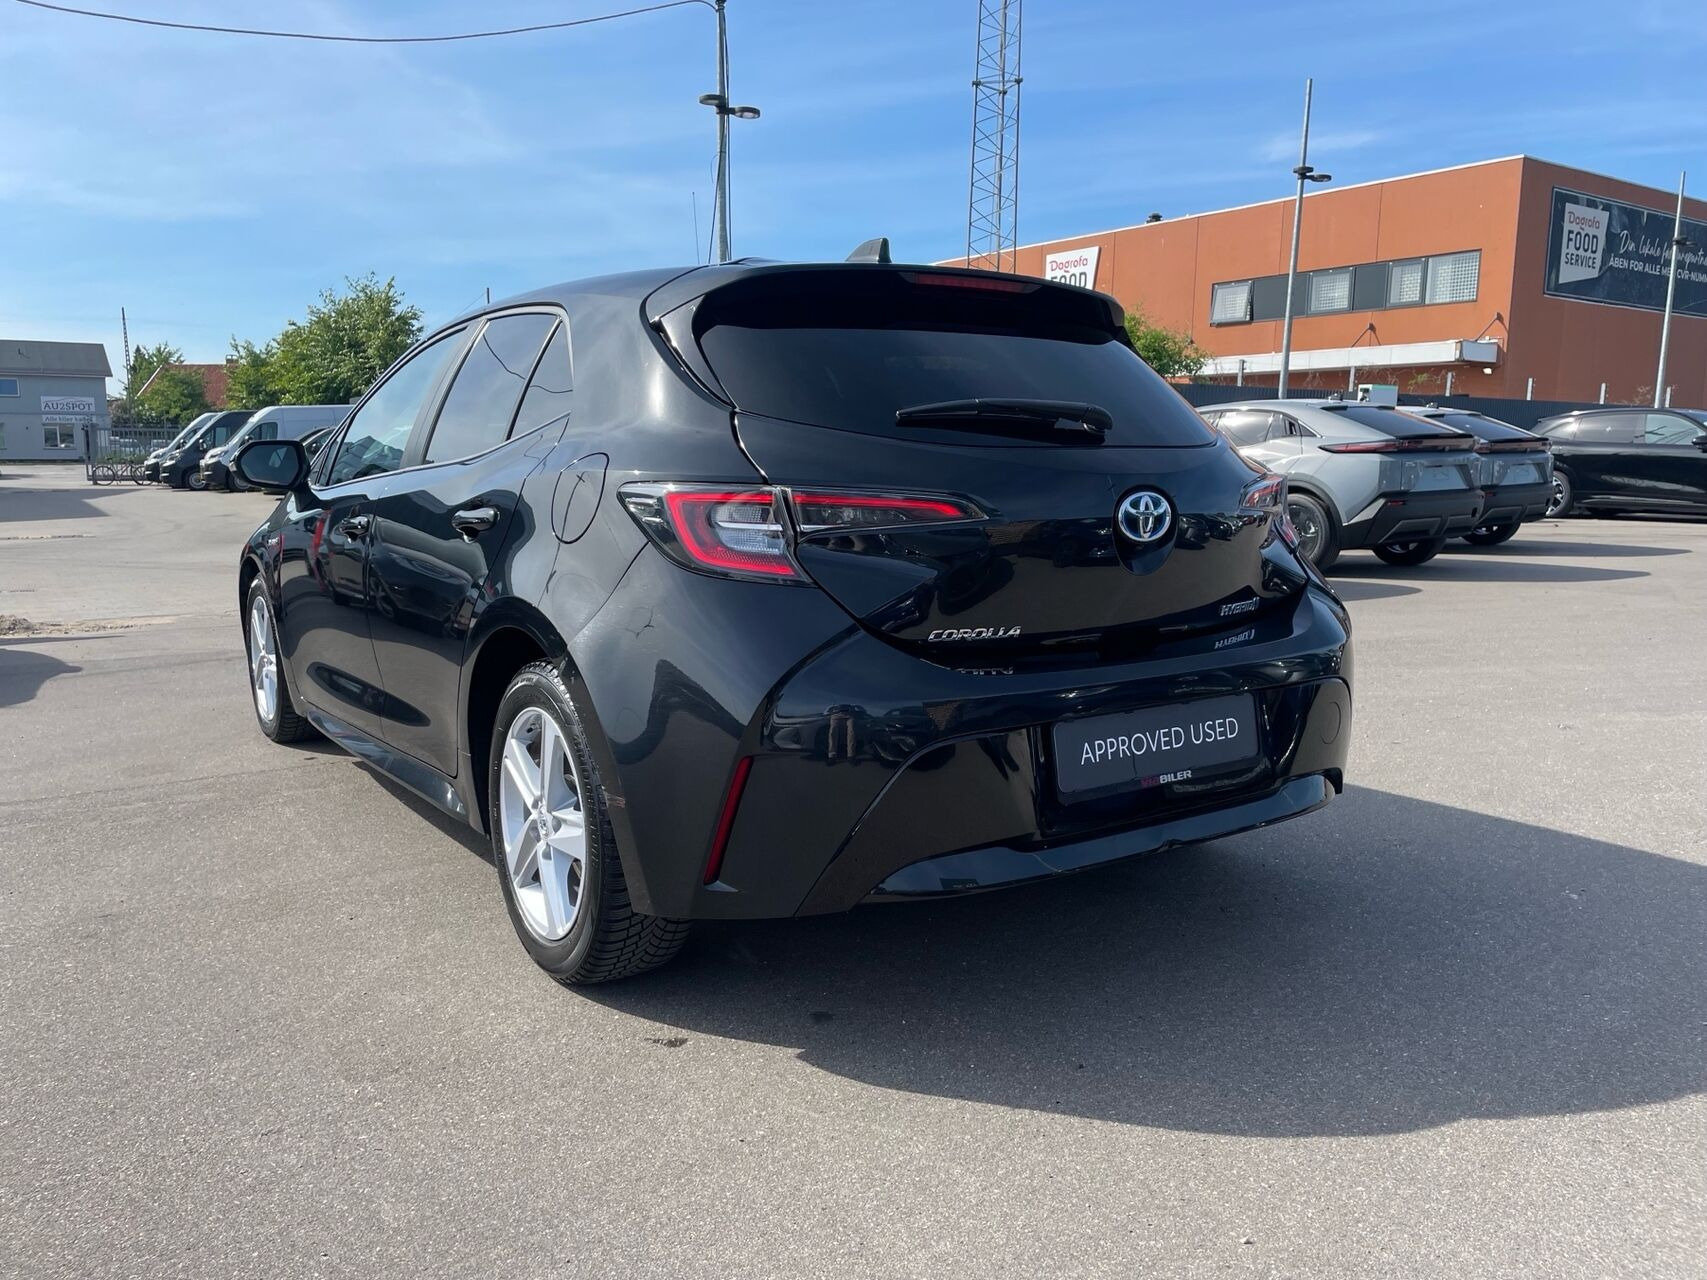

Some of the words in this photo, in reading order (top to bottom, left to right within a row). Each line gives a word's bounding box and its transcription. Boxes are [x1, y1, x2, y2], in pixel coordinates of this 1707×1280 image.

[1567, 211, 1600, 231] Dagrofa
[1566, 229, 1599, 254] FOOD
[1049, 256, 1088, 273] Dagrofa
[1564, 252, 1597, 269] SERVICE
[1609, 253, 1628, 268] ÅBEN
[1629, 261, 1644, 273] FOR
[1644, 264, 1661, 275] ALLE
[43, 401, 93, 411] AU2SPOT
[927, 626, 1022, 642] COROLLA
[1081, 727, 1185, 765] APPROVED
[1190, 718, 1239, 744] USED
